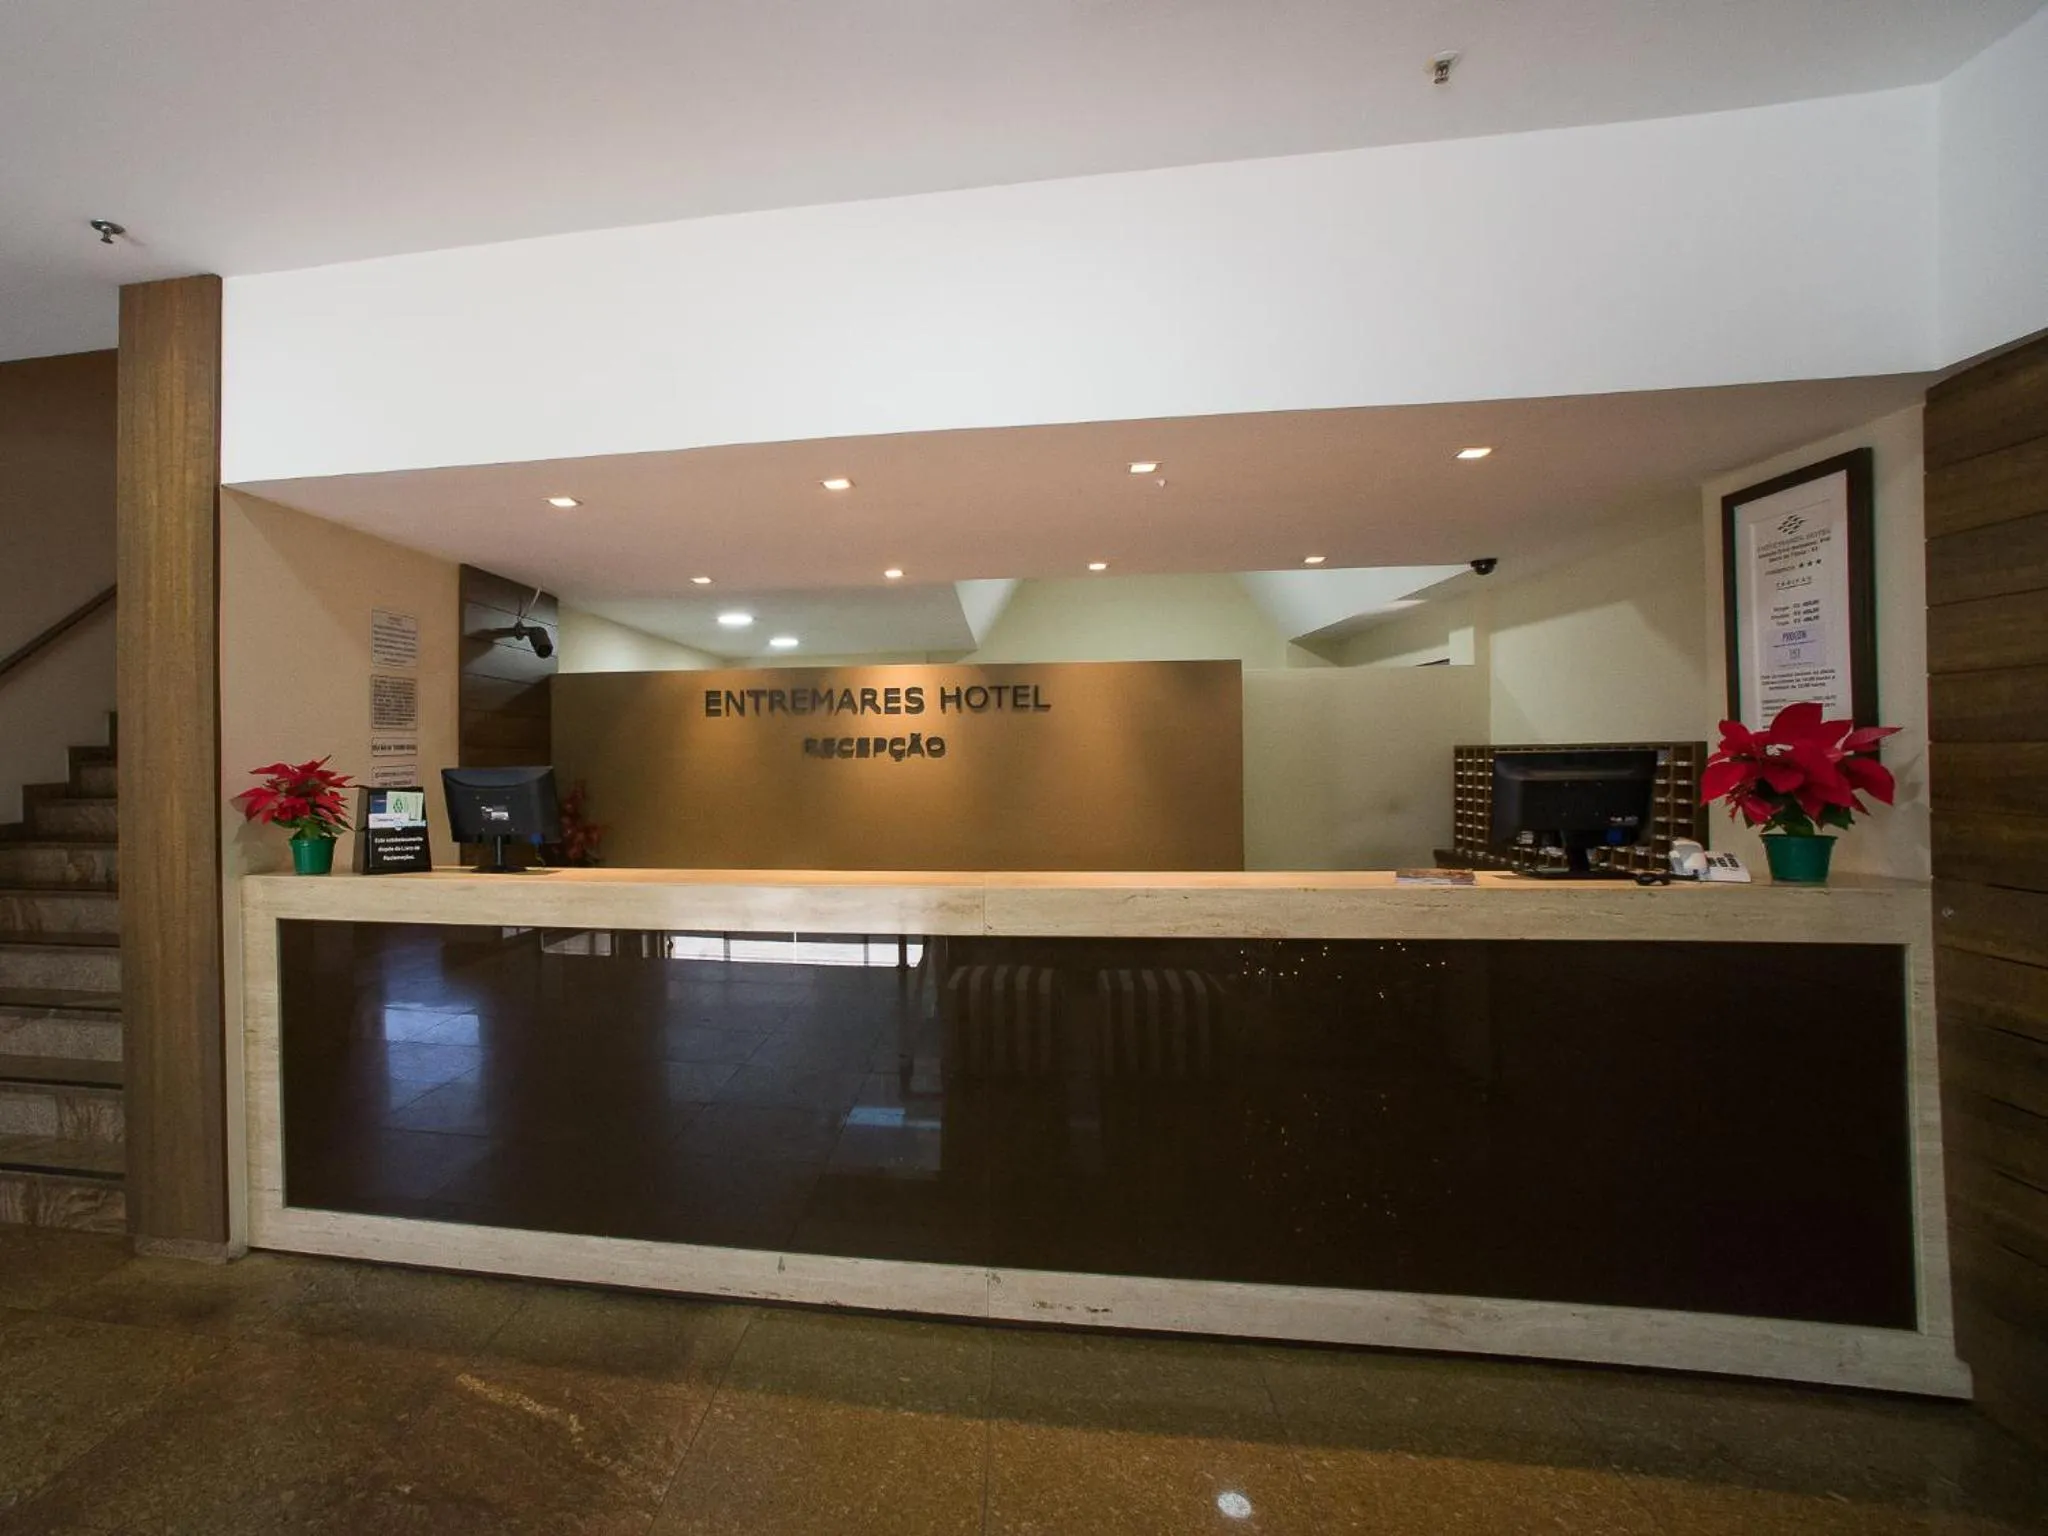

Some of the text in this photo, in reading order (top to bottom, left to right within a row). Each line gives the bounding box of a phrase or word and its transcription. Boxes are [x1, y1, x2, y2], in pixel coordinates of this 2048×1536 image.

[704, 685, 1052, 717] ENTREMARES HOTEL
[804, 733, 946, 762] RECEPÇÃO
